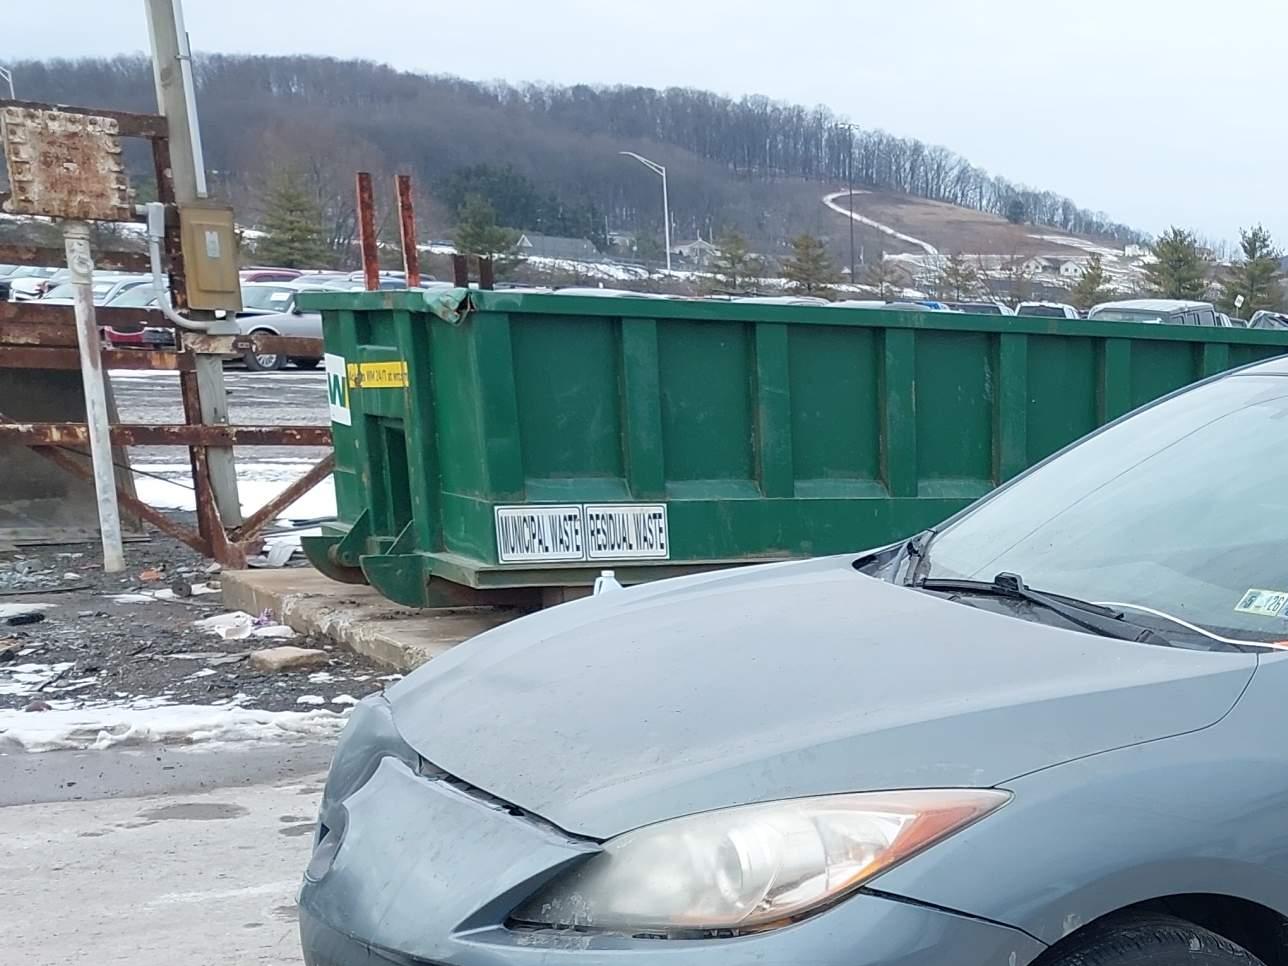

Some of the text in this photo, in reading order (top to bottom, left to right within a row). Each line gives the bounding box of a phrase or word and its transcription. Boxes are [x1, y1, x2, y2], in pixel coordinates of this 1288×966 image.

[501, 514, 581, 555] MUNICIPAL WASTE
[589, 512, 665, 551] RESIDUAL WASTE
